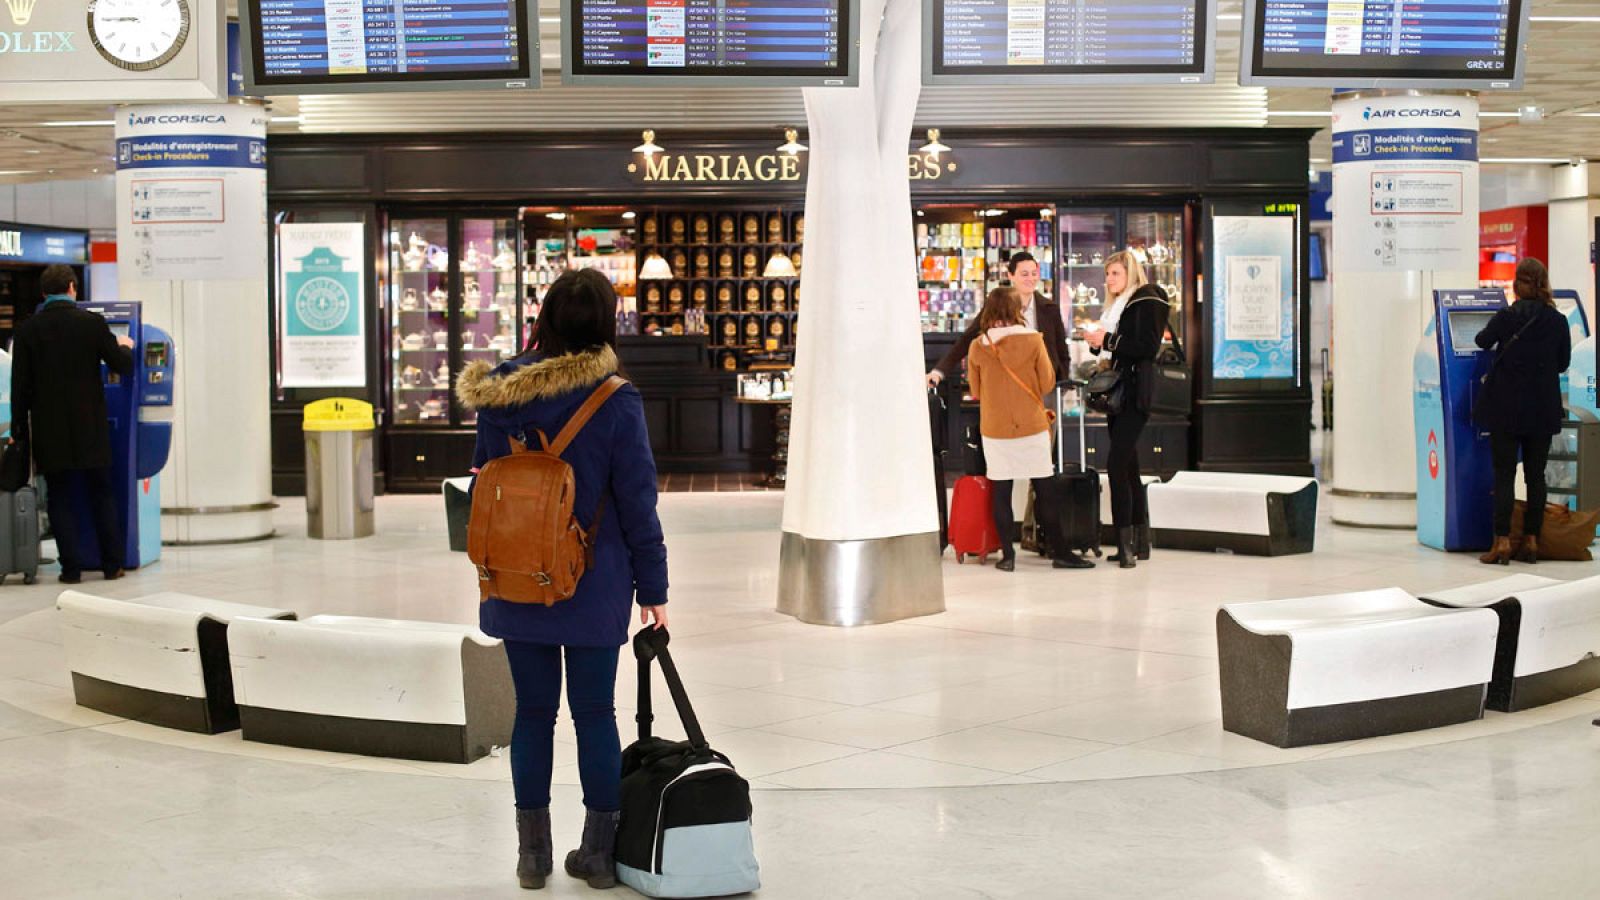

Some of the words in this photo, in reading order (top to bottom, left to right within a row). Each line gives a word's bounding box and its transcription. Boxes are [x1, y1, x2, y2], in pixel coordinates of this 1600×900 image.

[1466, 60, 1493, 69] GRÈVE
[1372, 109, 1397, 118] AIR
[1398, 109, 1461, 118] CORSICA
[134, 116, 156, 124] AIR
[158, 115, 226, 124] CORSICA
[1374, 136, 1414, 144] Modalités
[1375, 145, 1409, 153] Check-in
[1411, 145, 1452, 153] Procedures
[133, 153, 162, 161] Check-in
[644, 154, 800, 181] MARIAGE
